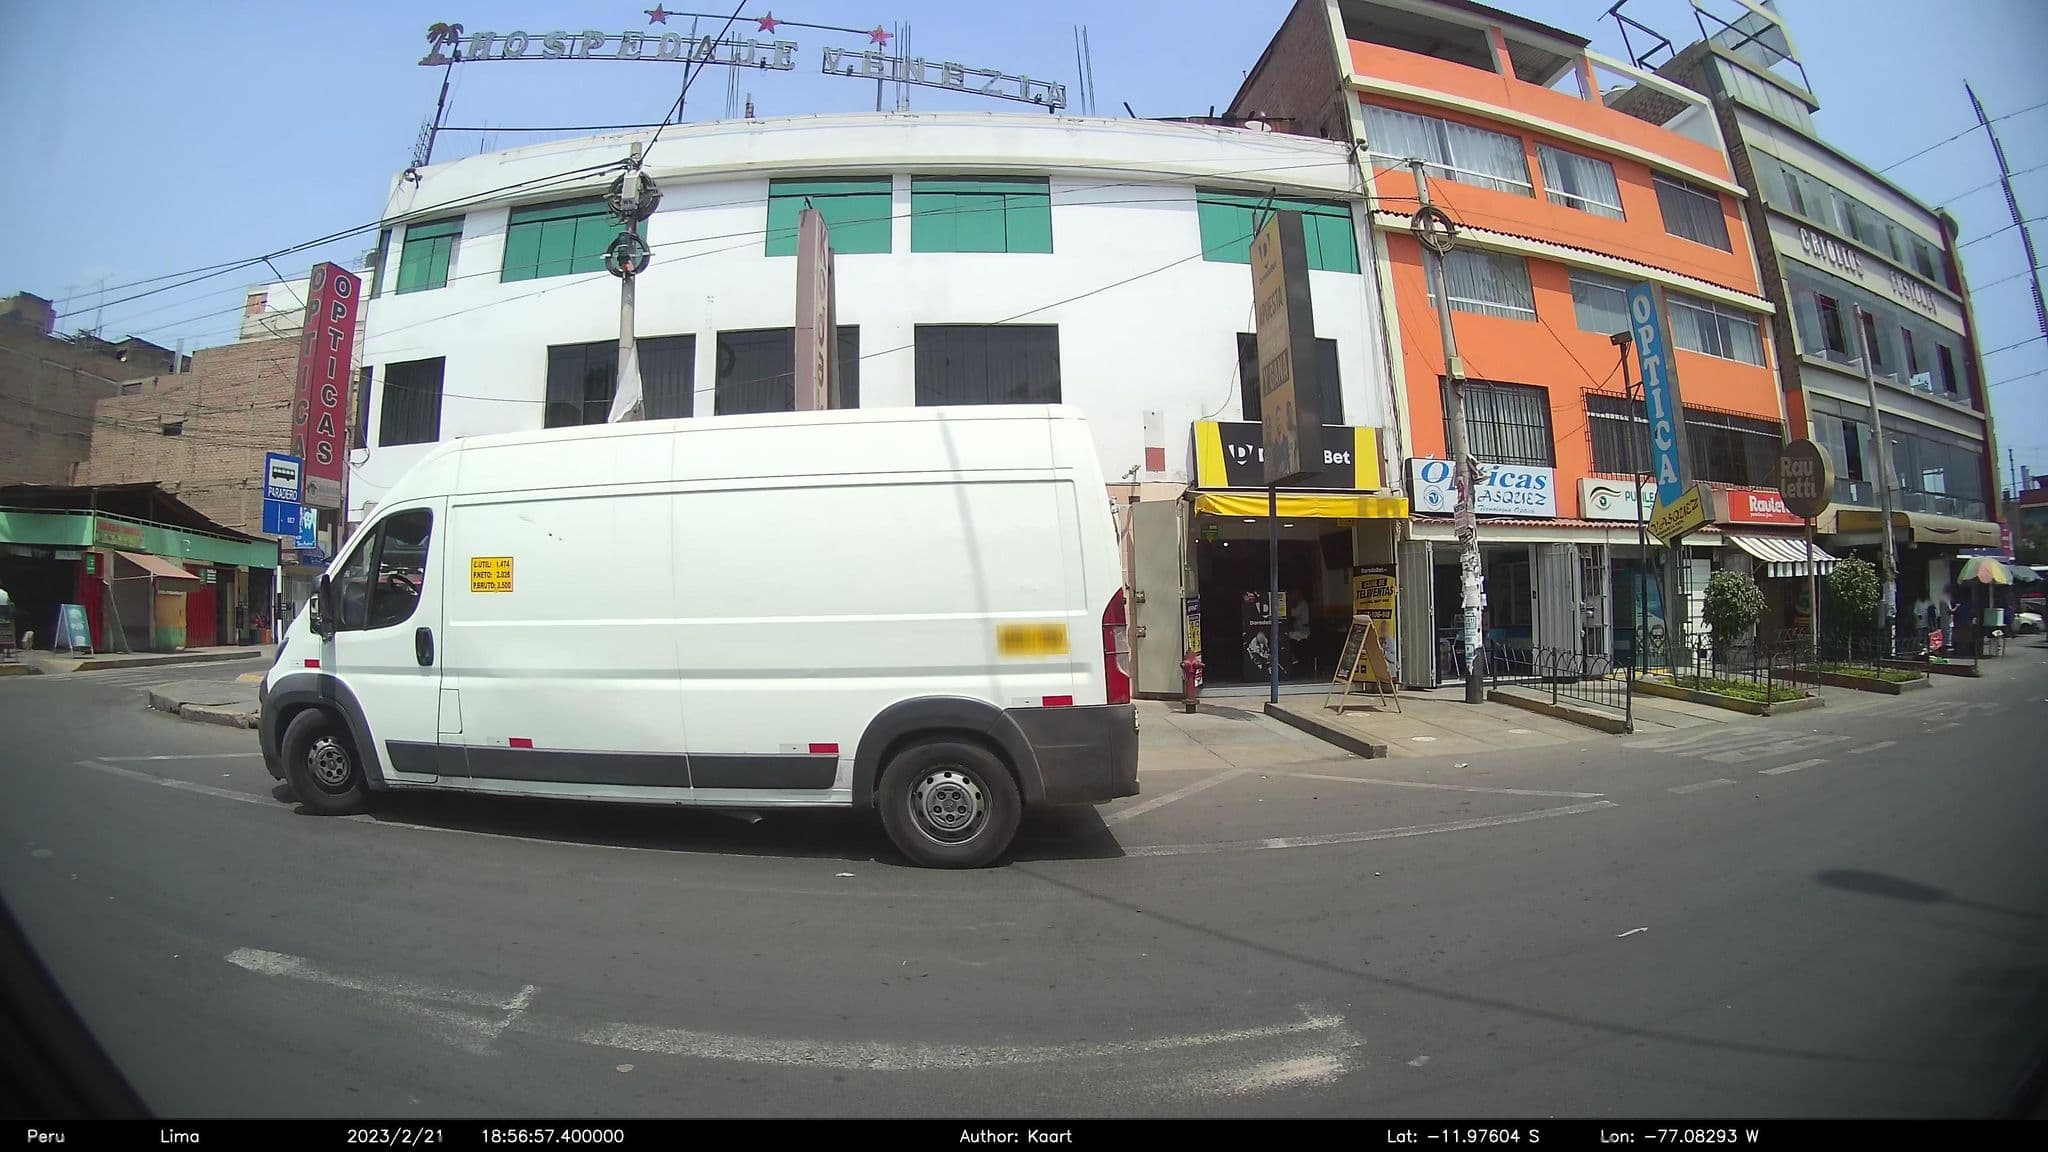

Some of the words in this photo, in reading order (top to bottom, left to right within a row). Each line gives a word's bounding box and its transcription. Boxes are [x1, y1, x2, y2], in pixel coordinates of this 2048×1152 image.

[467, 30, 799, 71] HOSPEDAJE
[822, 46, 1066, 107] VENEZIA
[316, 274, 352, 465] OPTICAS
[1633, 294, 1678, 486] OPTICA
[1421, 461, 1547, 491] Oicas
[1781, 456, 1814, 477] Rau
[268, 486, 298, 501] PARADERO
[1477, 489, 1547, 506] ASQUEZ
[1749, 495, 1791, 513] Raulet
[496, 560, 510, 568] 1.474
[1356, 586, 1394, 600] TELEVENTAS
